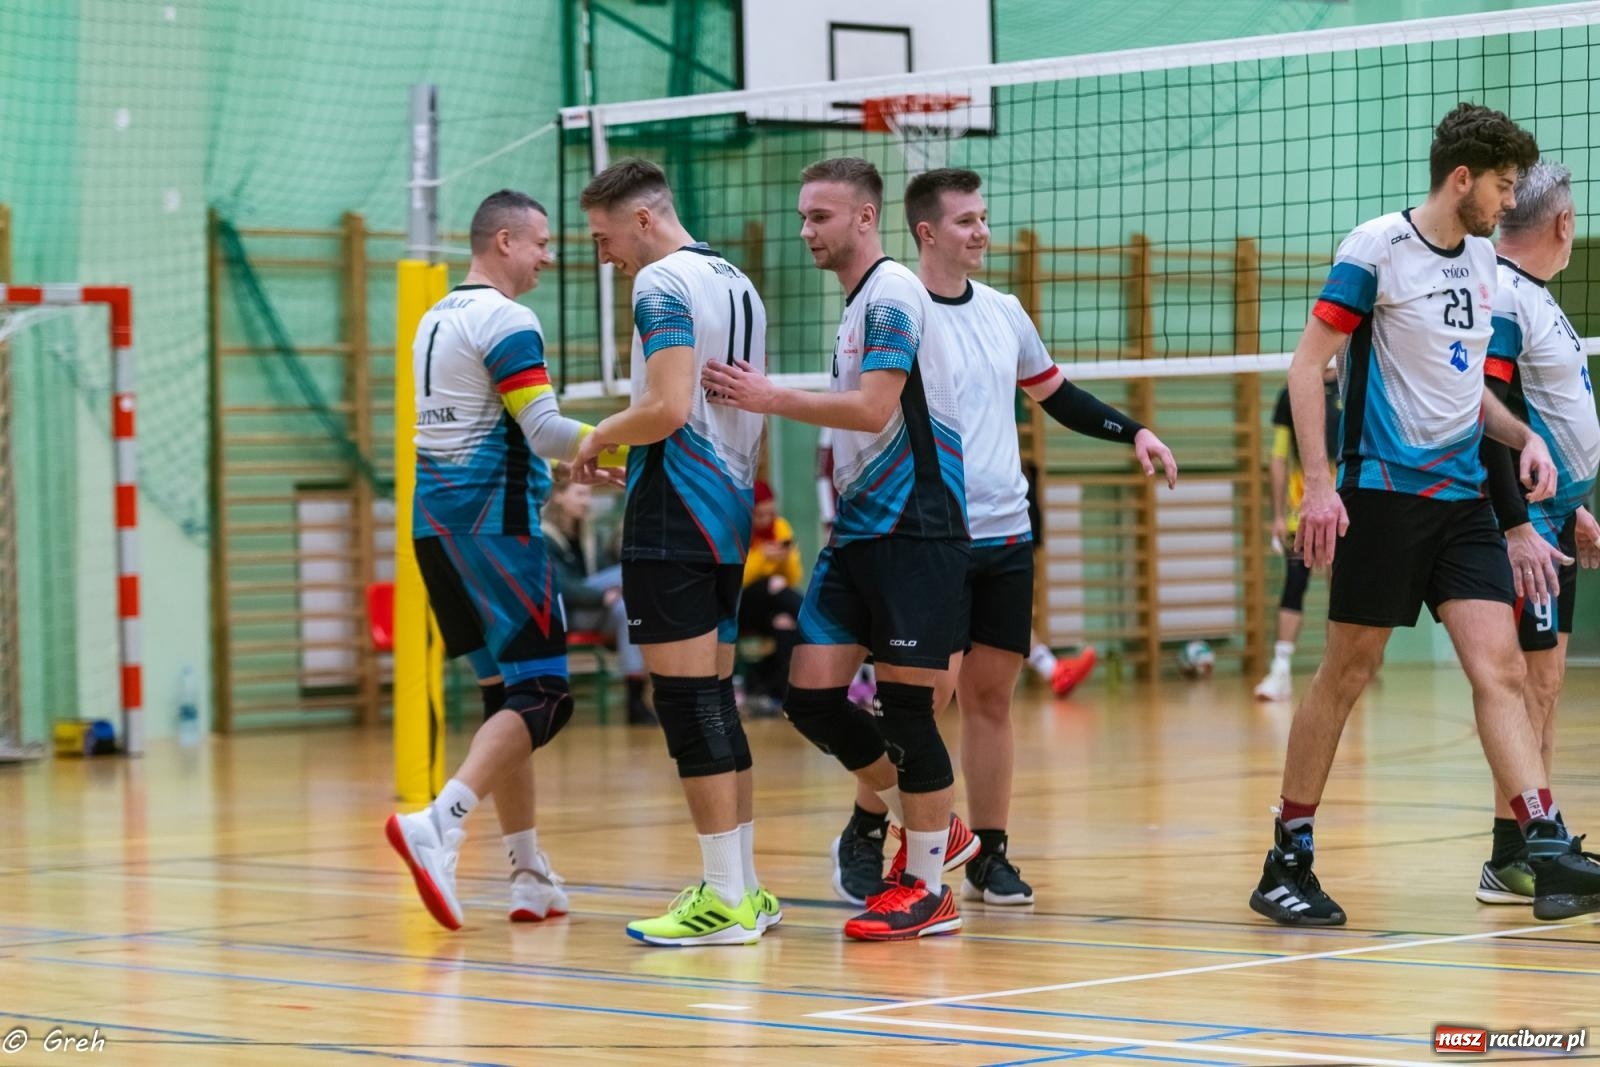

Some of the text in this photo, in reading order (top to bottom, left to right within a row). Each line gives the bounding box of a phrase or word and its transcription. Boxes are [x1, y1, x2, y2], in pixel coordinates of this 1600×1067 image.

[1442, 288, 1474, 330] 23
[424, 320, 440, 397] 1
[1534, 592, 1552, 632] 9
[889, 639, 918, 647] COLO
